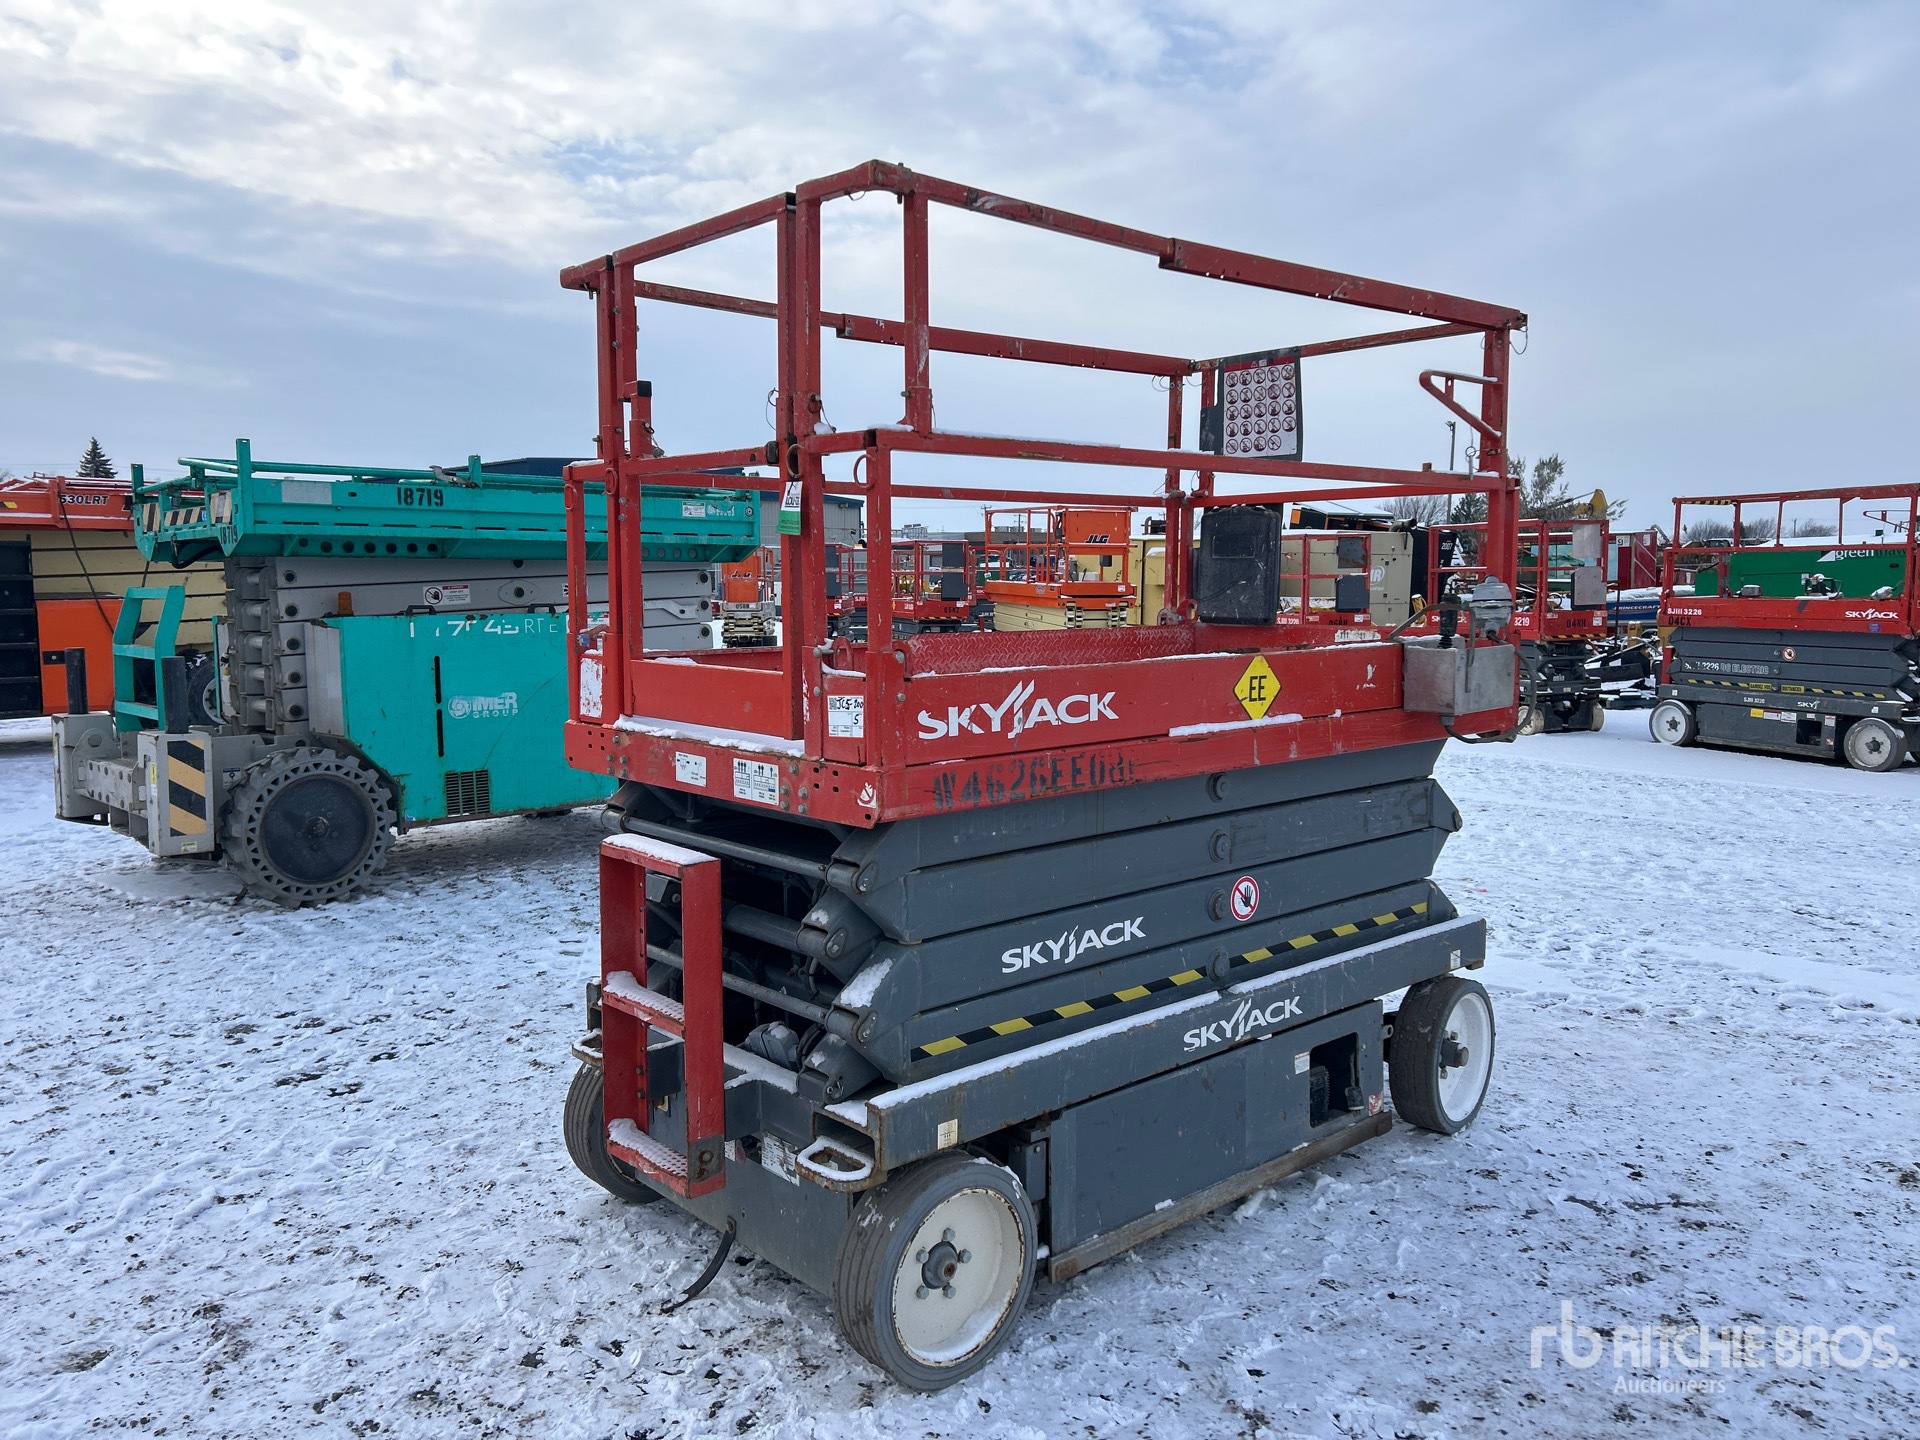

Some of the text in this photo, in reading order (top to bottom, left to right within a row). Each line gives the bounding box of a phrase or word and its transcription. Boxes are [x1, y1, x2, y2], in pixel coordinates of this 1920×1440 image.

[60, 494, 109, 505] 530LRT
[396, 487, 444, 507] 18719
[1084, 534, 1110, 544] JLG
[1683, 608, 1702, 616] 3226
[1844, 608, 1899, 620] SKYJACK
[1513, 616, 1530, 627] 3219
[1668, 616, 1692, 626] 04CX
[1249, 675, 1267, 702] EE
[472, 691, 518, 711] IMER
[473, 708, 518, 718] GROUP
[917, 679, 1119, 740] SKYJACK
[1001, 916, 1147, 974] SKYJACK
[1183, 995, 1304, 1052] SKYJACK
